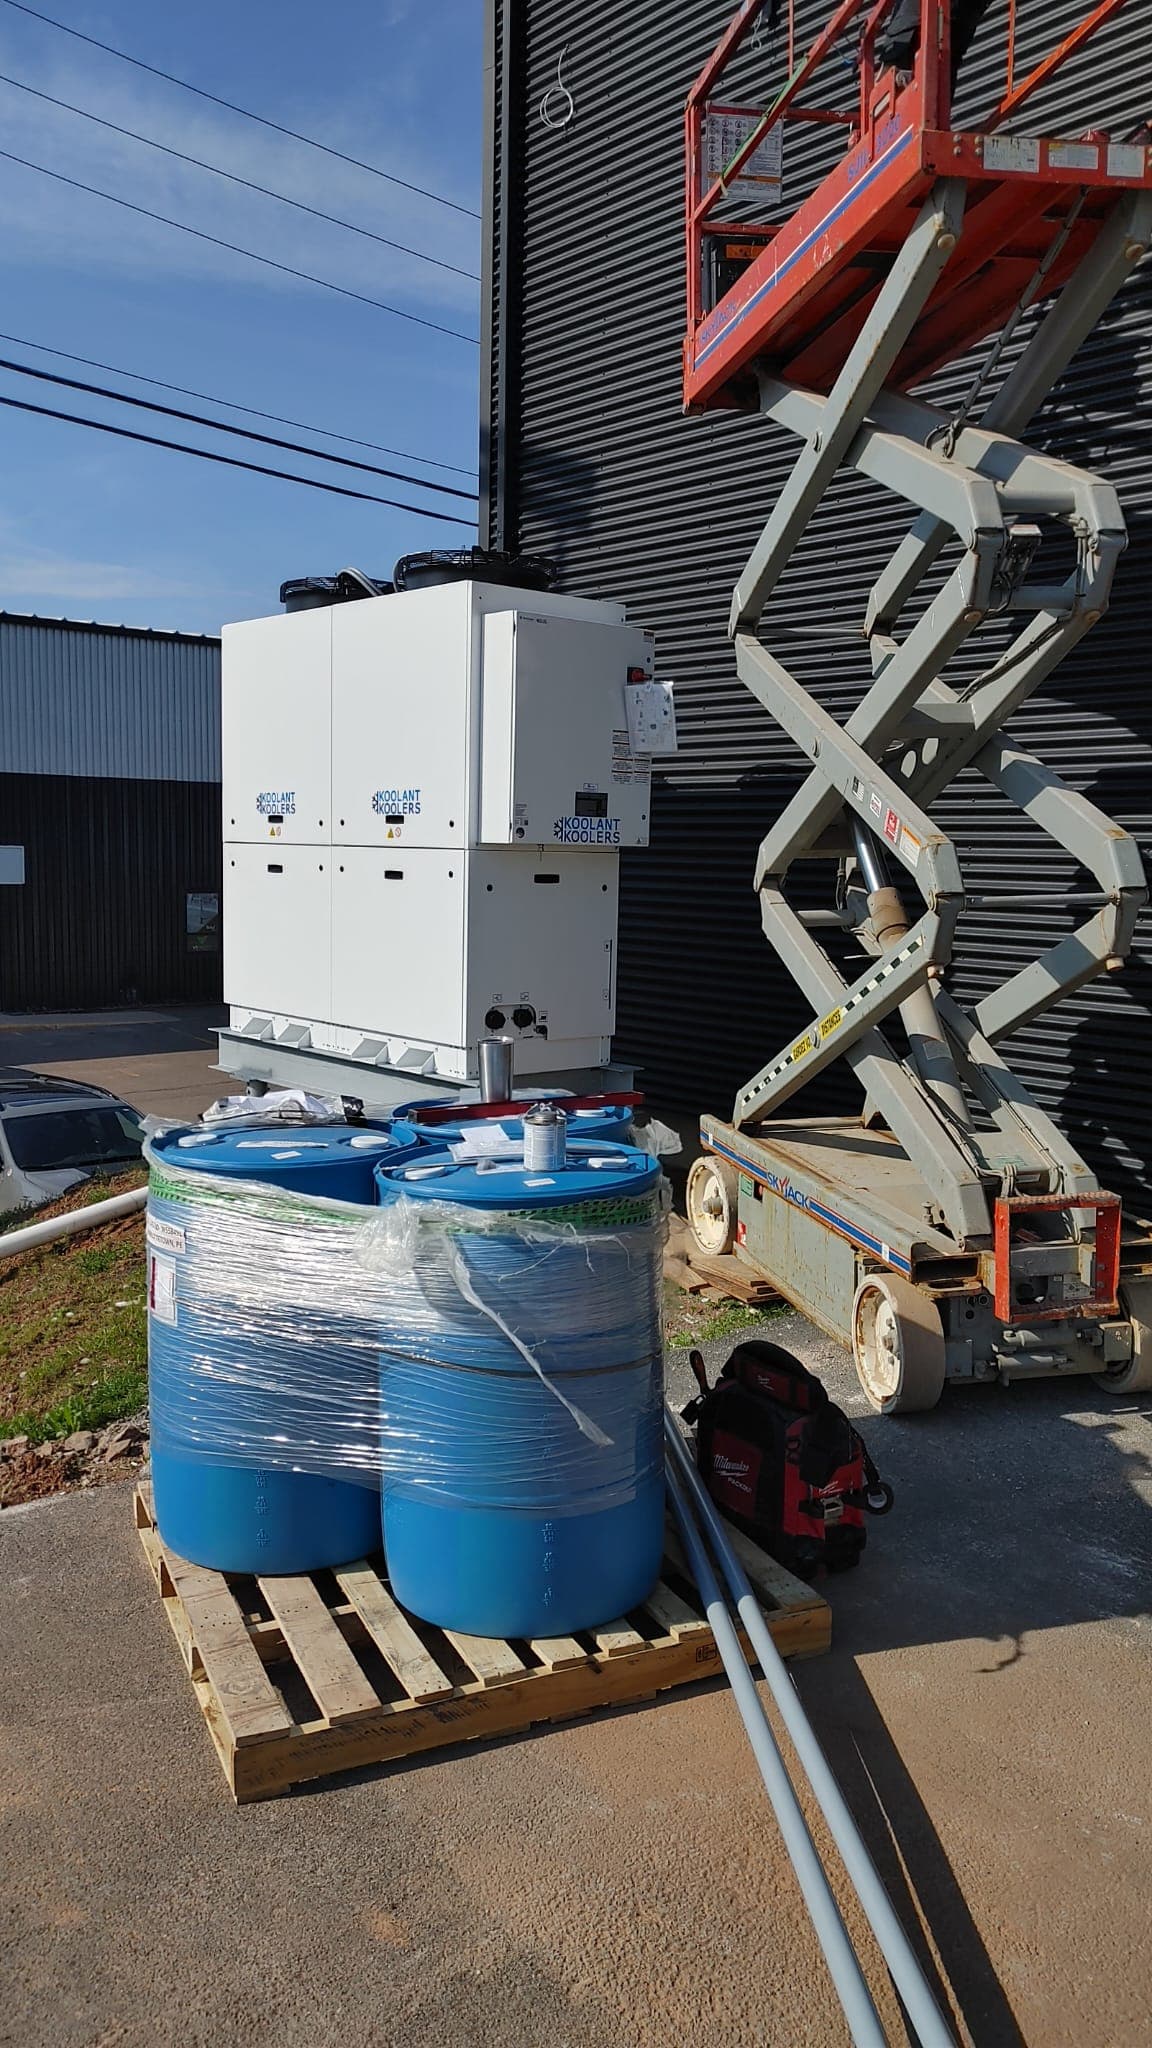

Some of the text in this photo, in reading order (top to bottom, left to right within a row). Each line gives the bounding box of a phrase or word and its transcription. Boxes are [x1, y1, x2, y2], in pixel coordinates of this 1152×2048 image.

[262, 792, 295, 803] KOOLANT
[379, 789, 421, 802] KOOLANT
[262, 803, 295, 815] KOOLERS
[379, 802, 421, 815] KOOLERS
[563, 817, 621, 830] KOOLANT
[563, 830, 620, 843] KOOLERS
[767, 1172, 811, 1210] SKYJACK
[713, 1454, 750, 1472] Milwaukee
